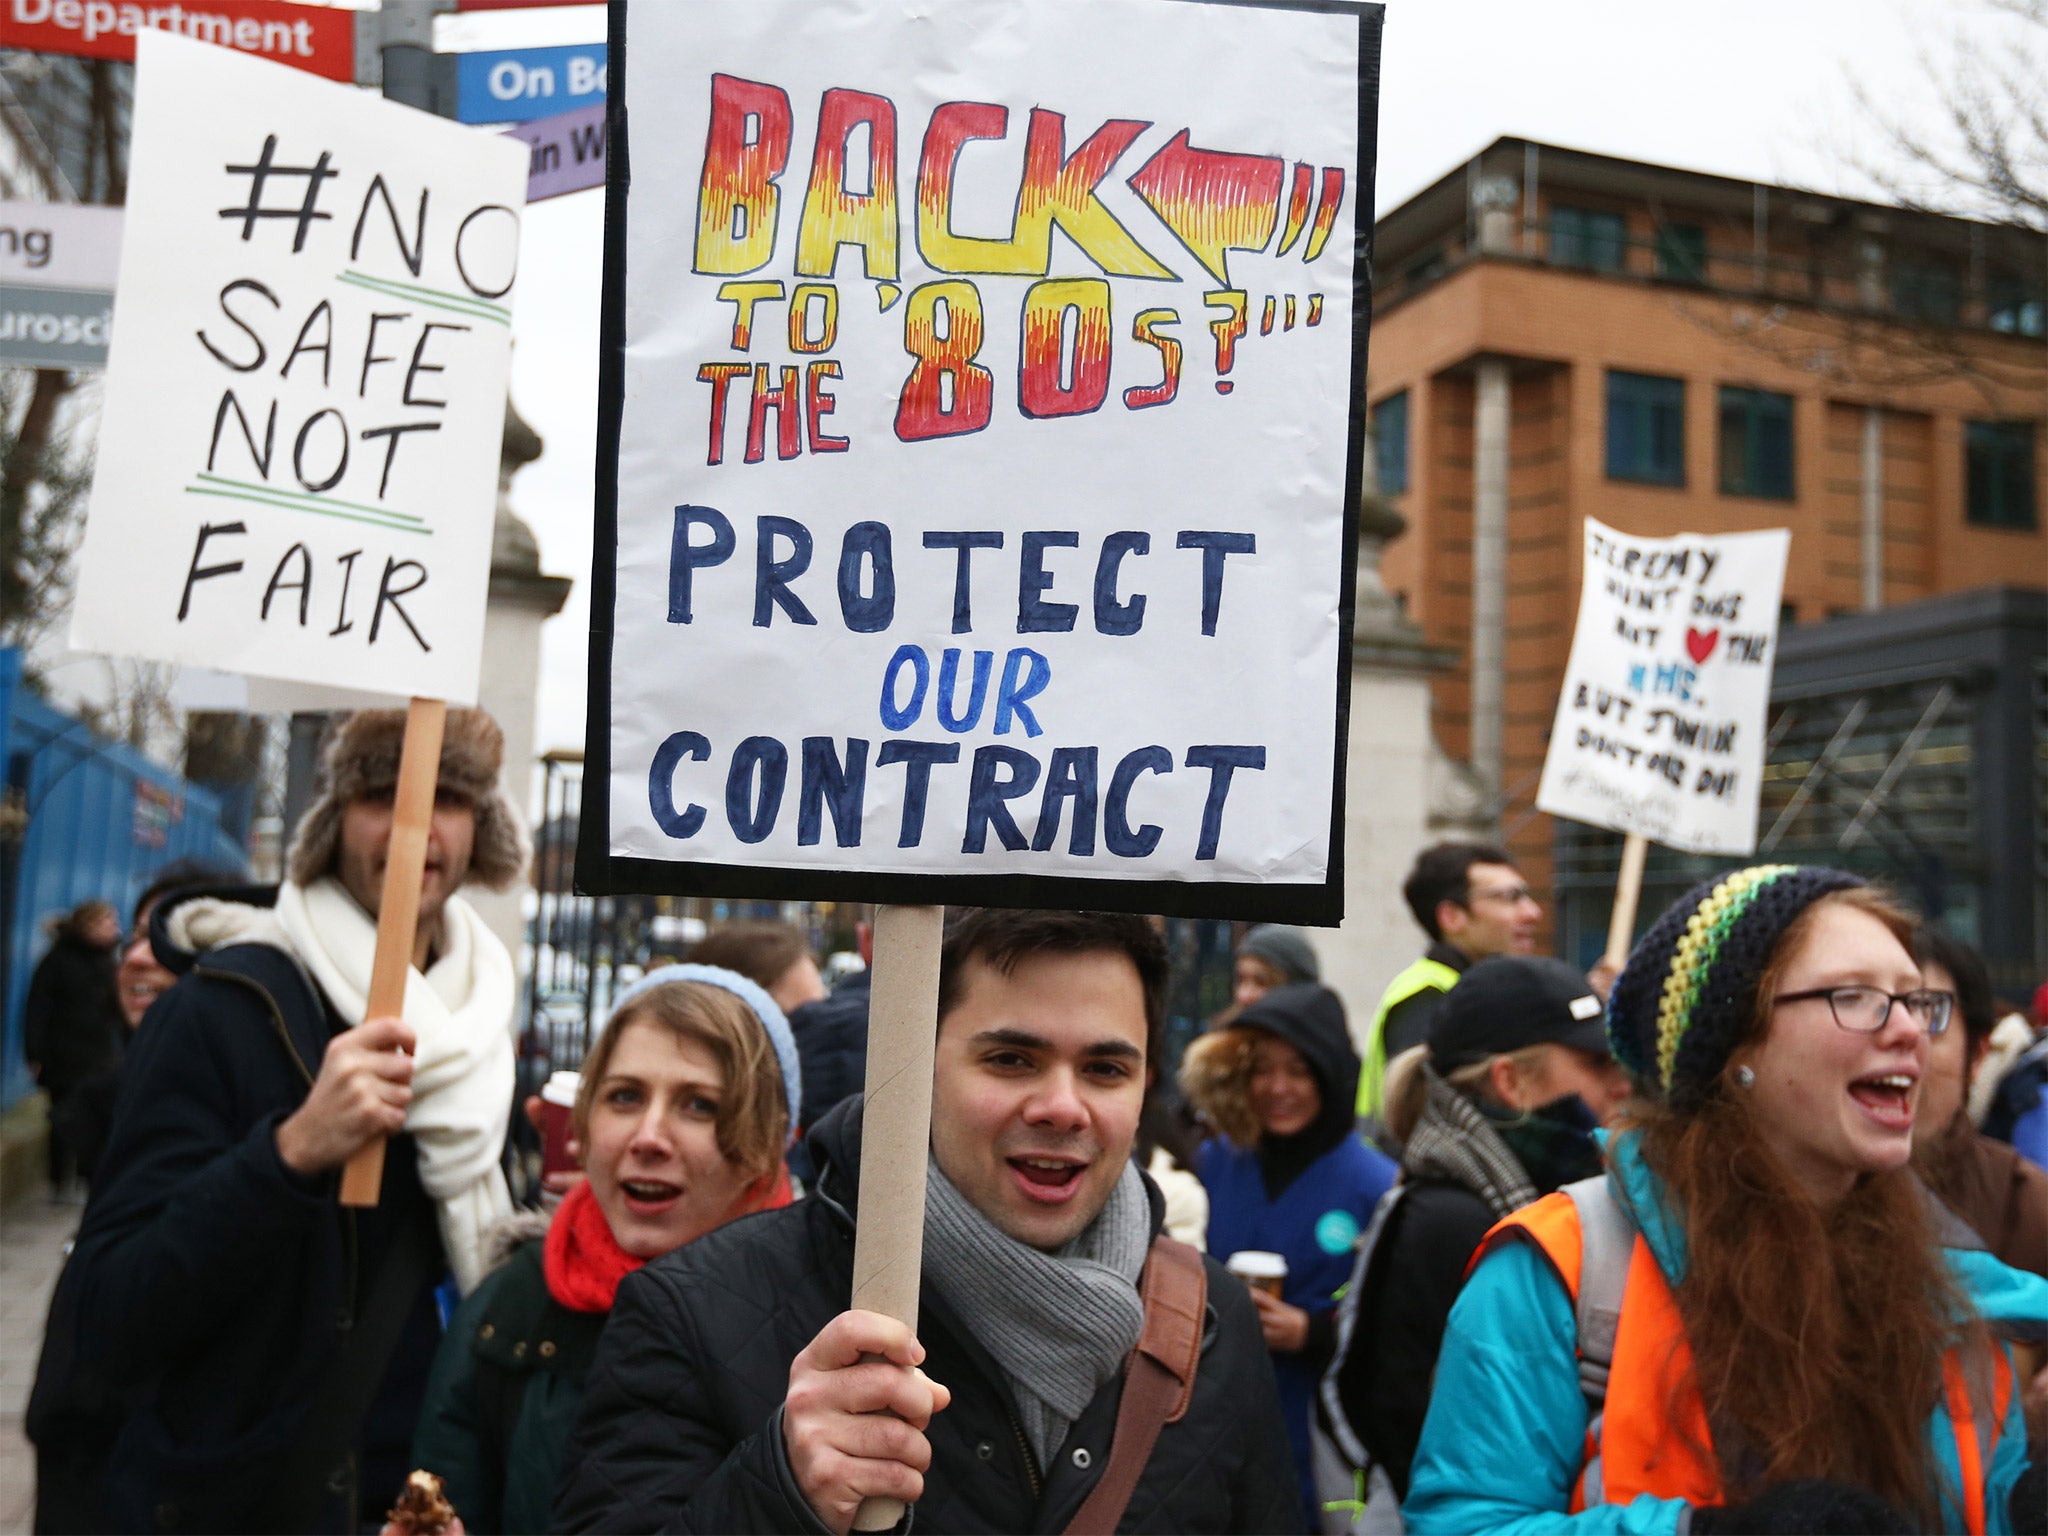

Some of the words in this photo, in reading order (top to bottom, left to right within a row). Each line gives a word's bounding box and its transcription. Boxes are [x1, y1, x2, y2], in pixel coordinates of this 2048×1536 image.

[12, 0, 314, 56] Department
[489, 60, 555, 101] On
[529, 136, 561, 176] in
[691, 73, 1184, 282] BACK
[218, 133, 519, 299] #NO
[196, 278, 472, 409] SAFE
[716, 281, 838, 353] TO
[208, 388, 442, 500] NOT
[697, 361, 850, 466] THE
[177, 521, 432, 653] FAIR
[667, 504, 1256, 637] PROTECT
[879, 644, 1052, 738] OUR
[648, 731, 1266, 861] CONTRACT
